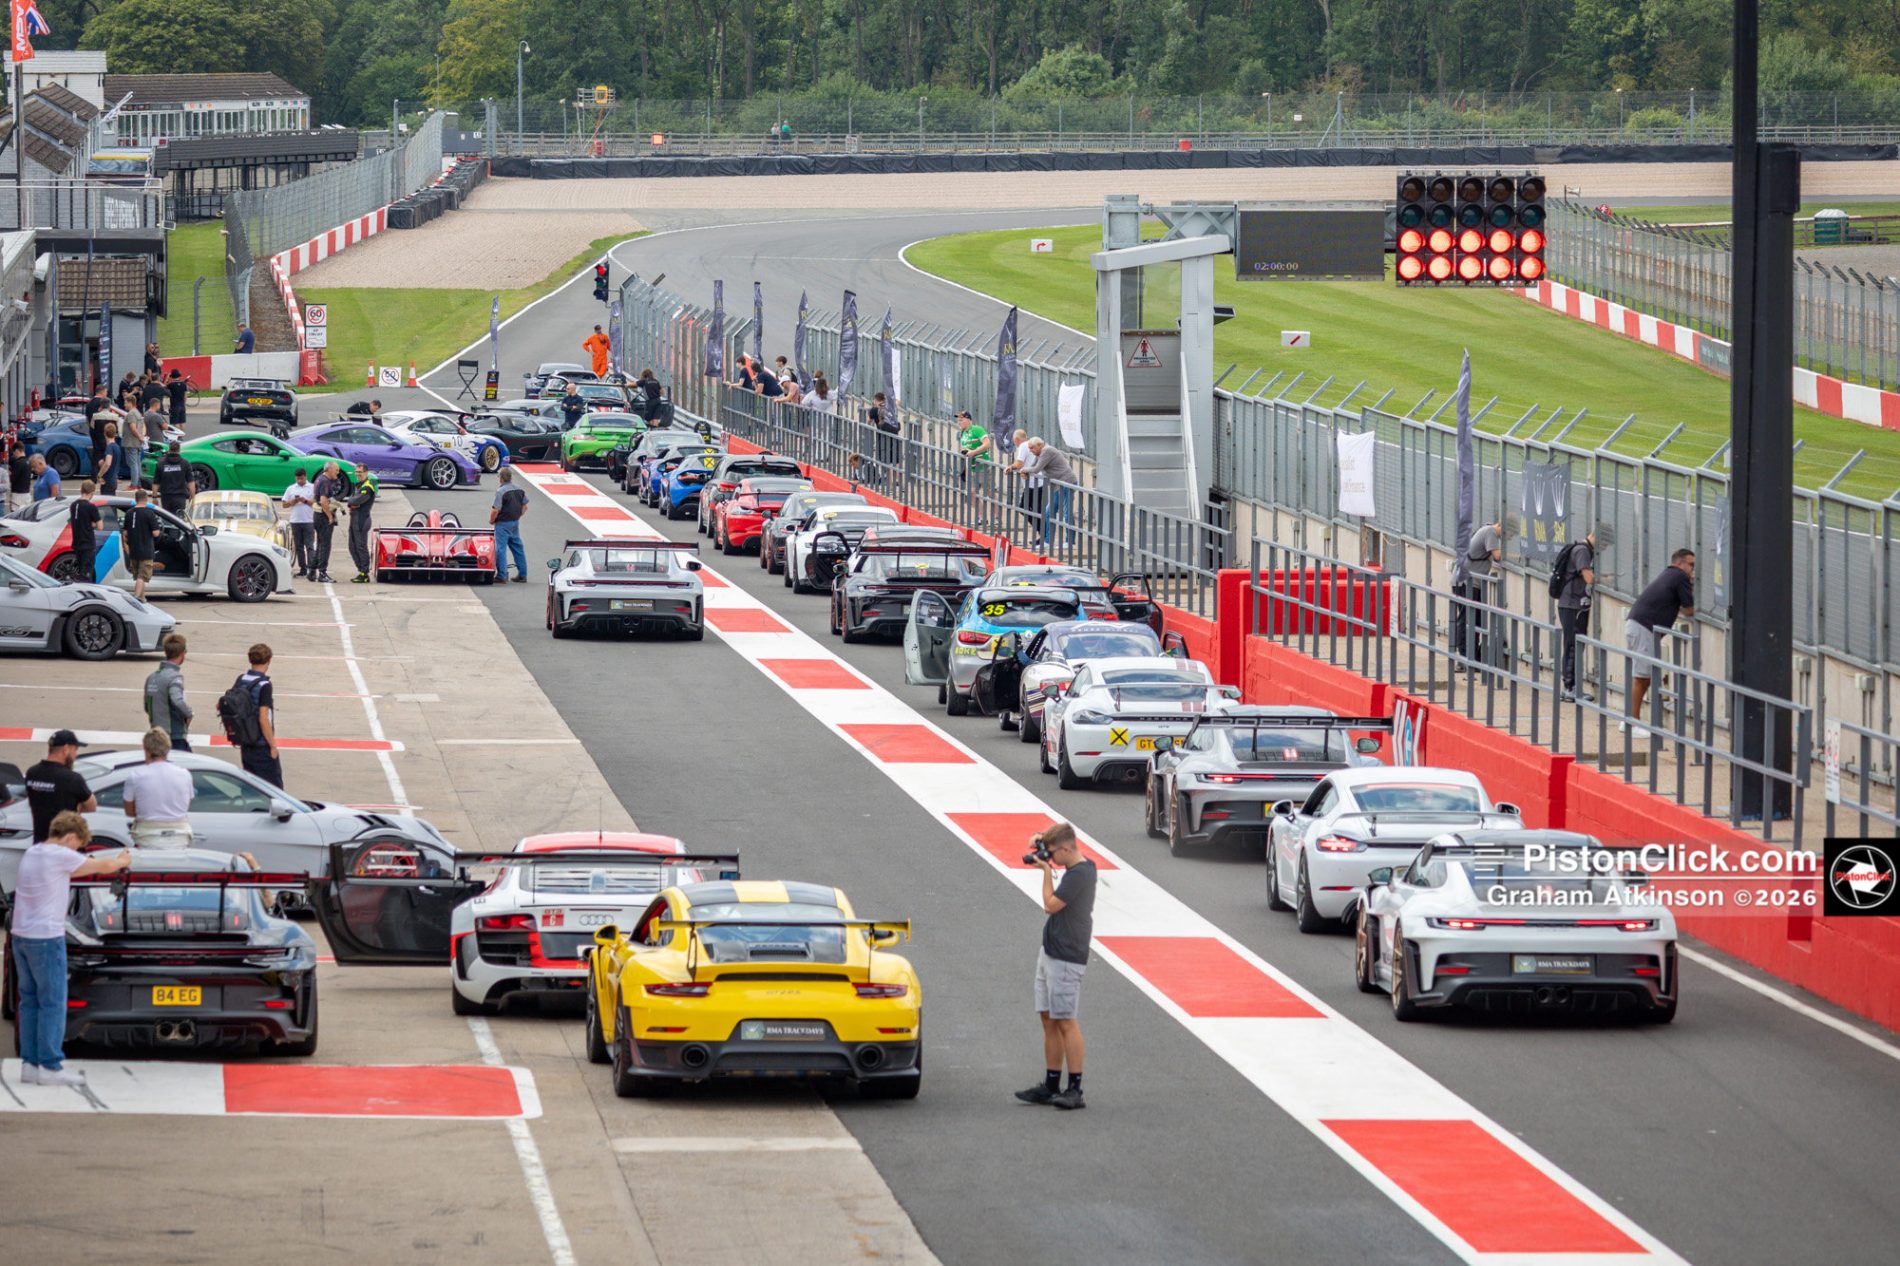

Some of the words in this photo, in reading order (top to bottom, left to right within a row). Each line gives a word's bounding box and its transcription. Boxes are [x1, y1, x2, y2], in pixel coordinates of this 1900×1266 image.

[1254, 263, 1299, 271] 02:00:00
[983, 604, 1006, 616] 35
[1210, 718, 1383, 726] PORSCHE
[157, 989, 174, 1002] 84
[179, 989, 198, 1002] EG
[766, 1027, 782, 1035] RMA
